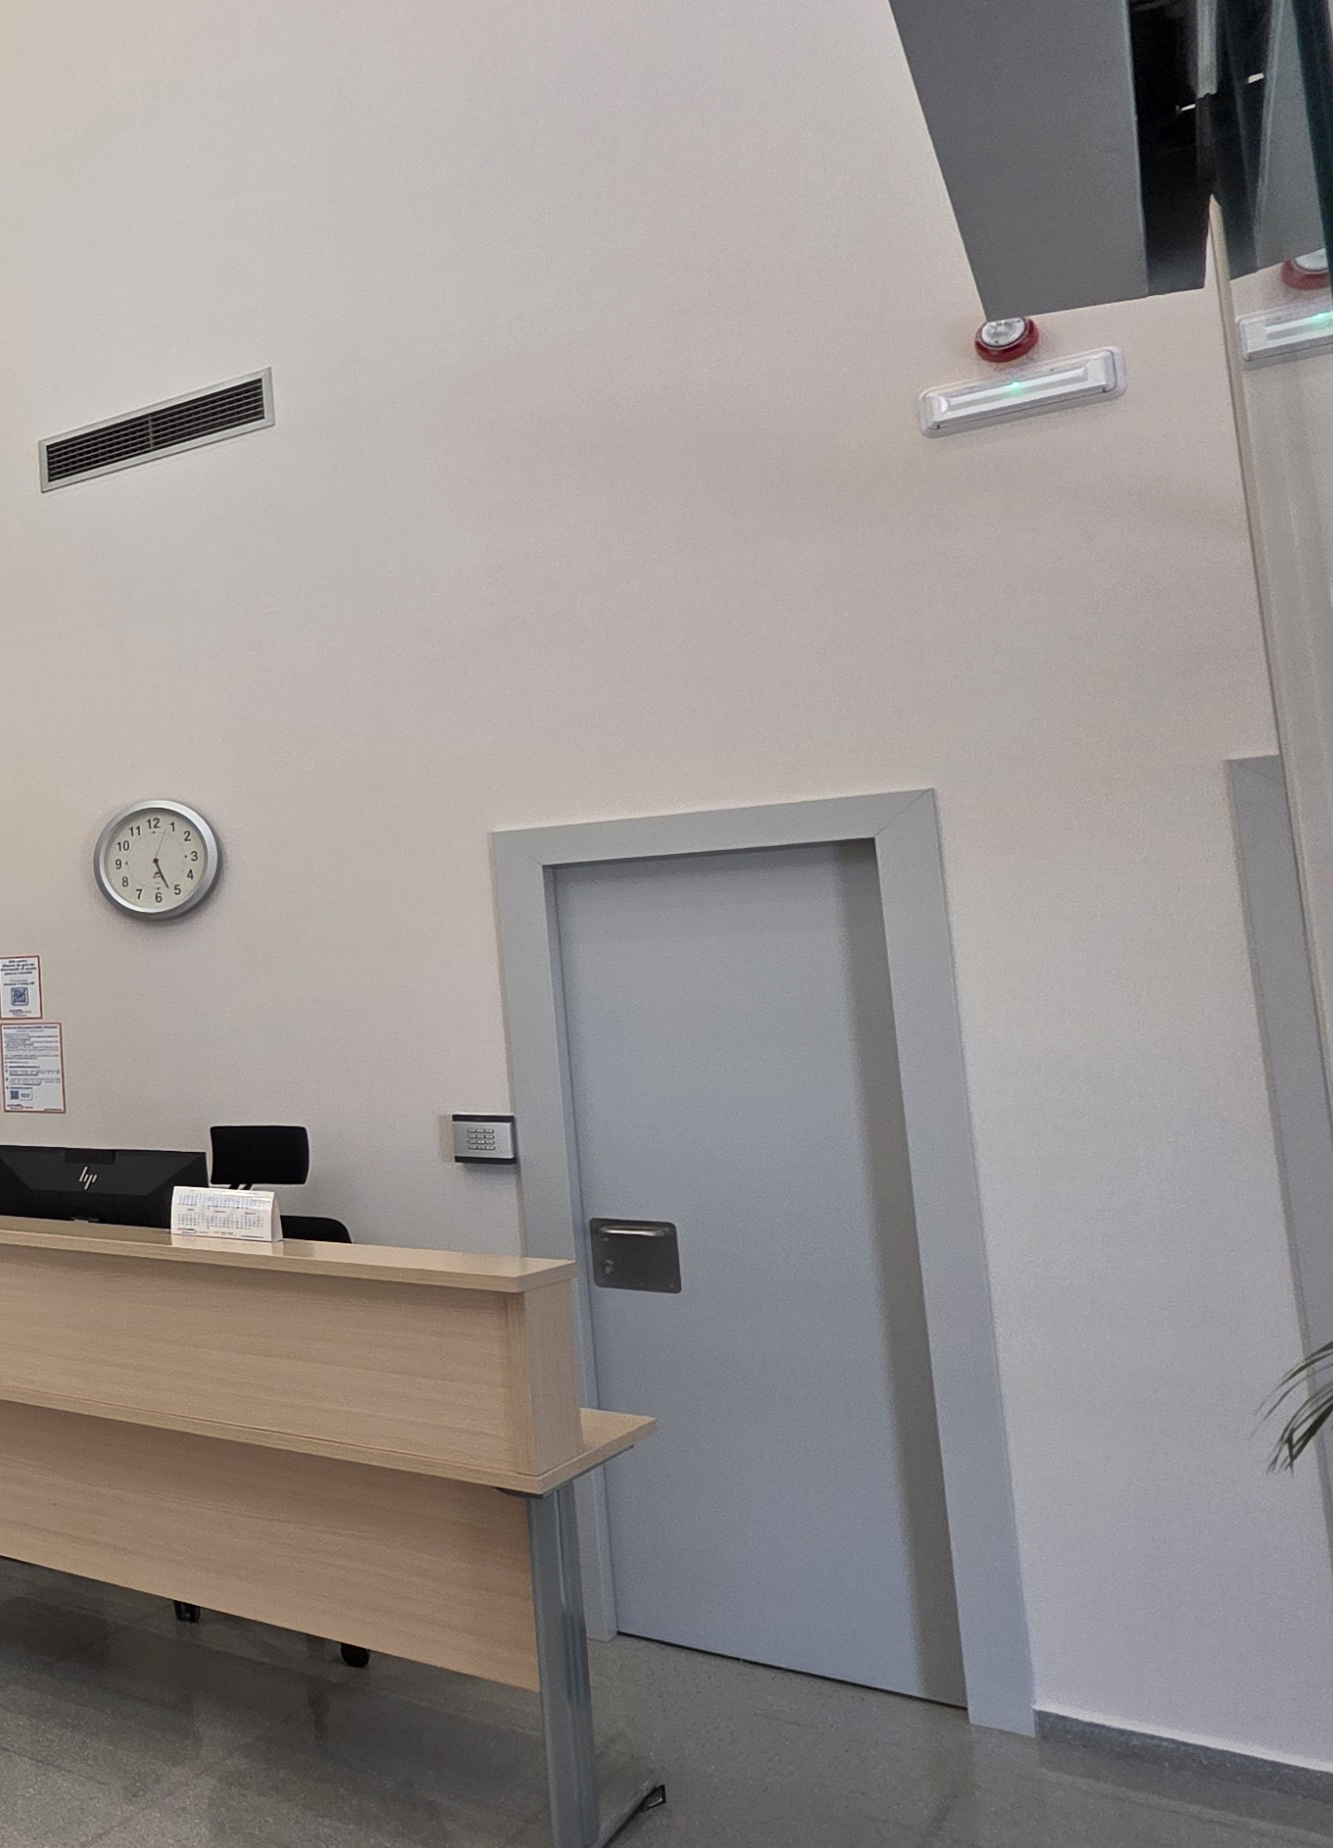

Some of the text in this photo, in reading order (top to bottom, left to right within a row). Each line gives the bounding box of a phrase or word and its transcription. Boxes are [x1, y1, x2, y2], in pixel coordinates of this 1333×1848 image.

[146, 817, 160, 829] 12
[170, 822, 175, 832] 1
[129, 825, 141, 837] 11
[183, 830, 191, 842] 2
[116, 840, 130, 852] 10
[190, 850, 198, 862] 3
[115, 858, 122, 870] 9
[186, 868, 194, 880] 4
[121, 876, 129, 887] 8
[135, 888, 143, 900] 7
[174, 884, 181, 895] 5
[155, 892, 163, 903] 6
[79, 1166, 97, 1190] hp
